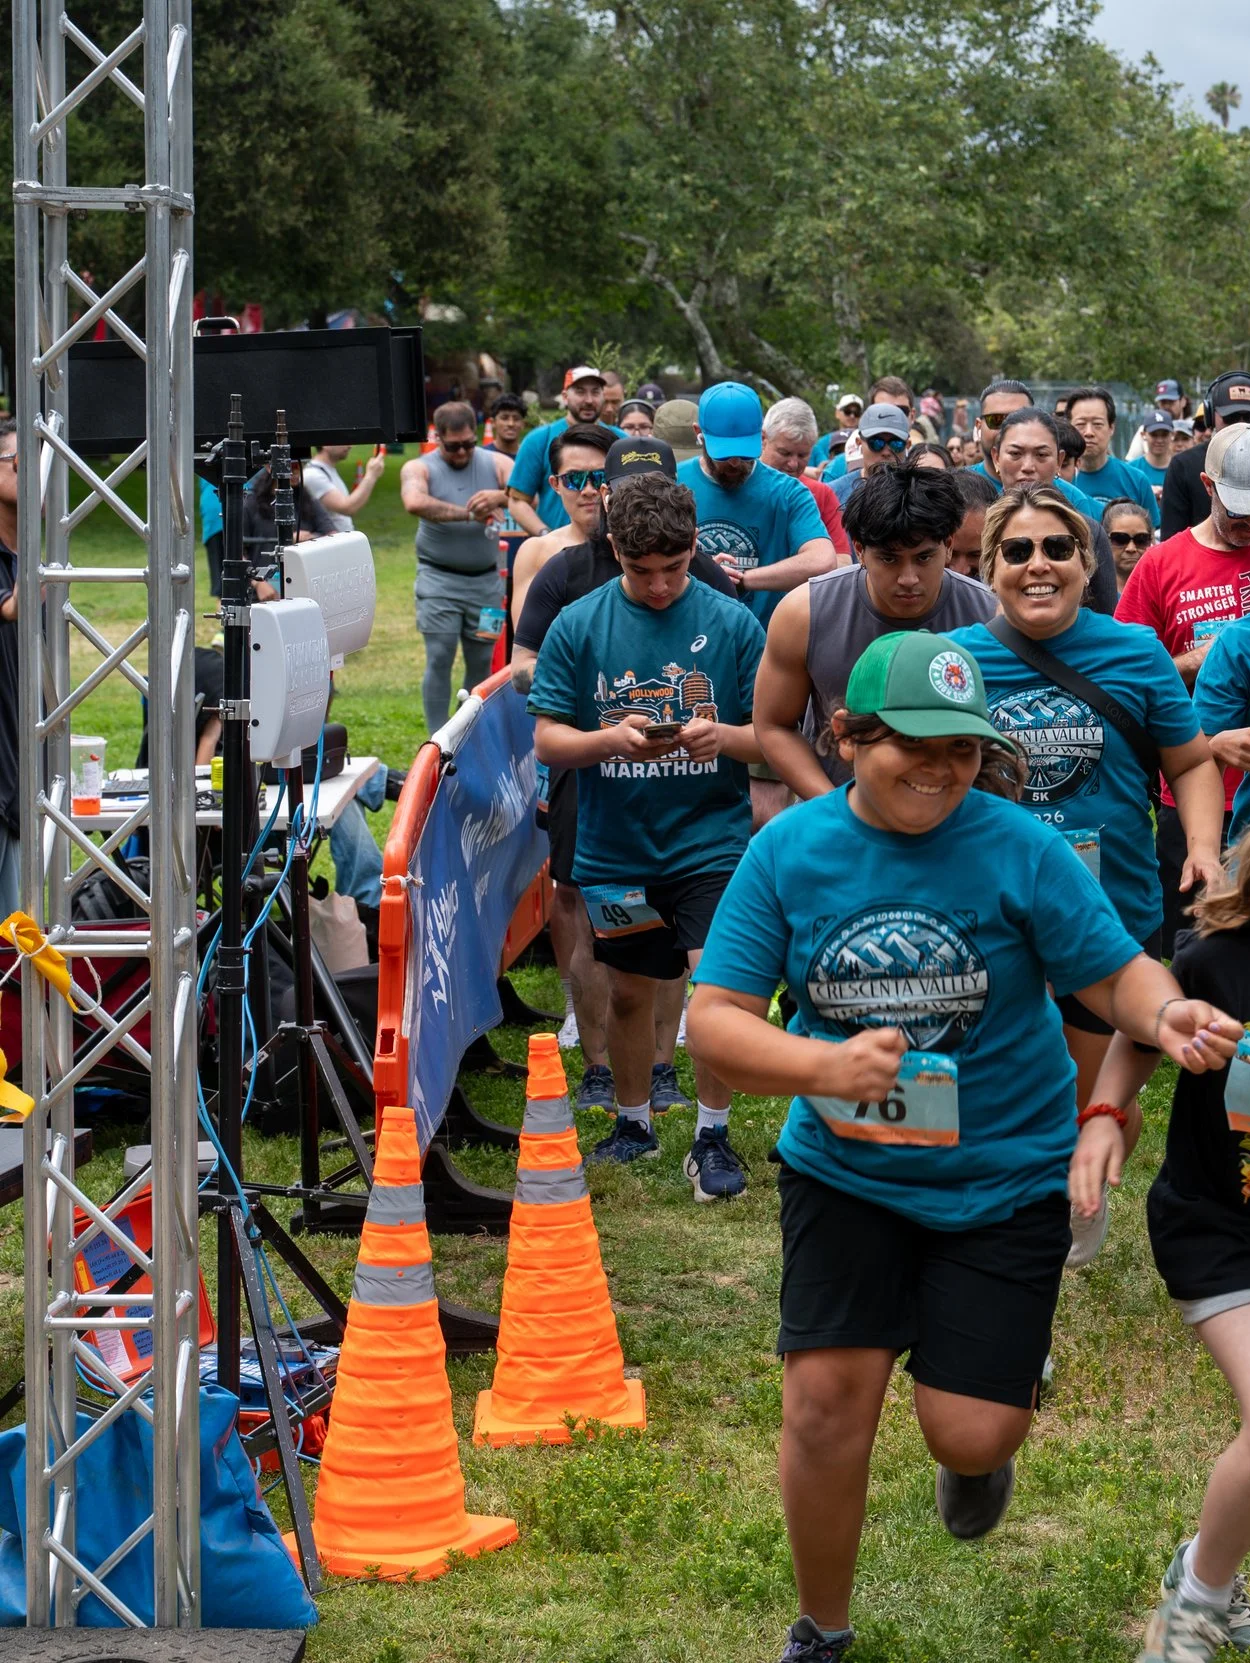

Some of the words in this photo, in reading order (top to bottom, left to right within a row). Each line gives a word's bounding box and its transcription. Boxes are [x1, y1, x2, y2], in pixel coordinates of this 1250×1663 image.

[1179, 584, 1234, 603] SMARTER
[1175, 595, 1238, 625] STRONGER
[628, 687, 674, 700] HOLLYWOOD
[1052, 728, 1098, 741] VALLEY
[1028, 746, 1089, 757] ETOWN
[600, 757, 718, 778] MARATHON
[1032, 792, 1050, 802] 5K
[1033, 810, 1065, 826] 026
[600, 903, 633, 927] 49
[815, 978, 914, 1000] CRESCENTA
[918, 973, 980, 995] VALLEY
